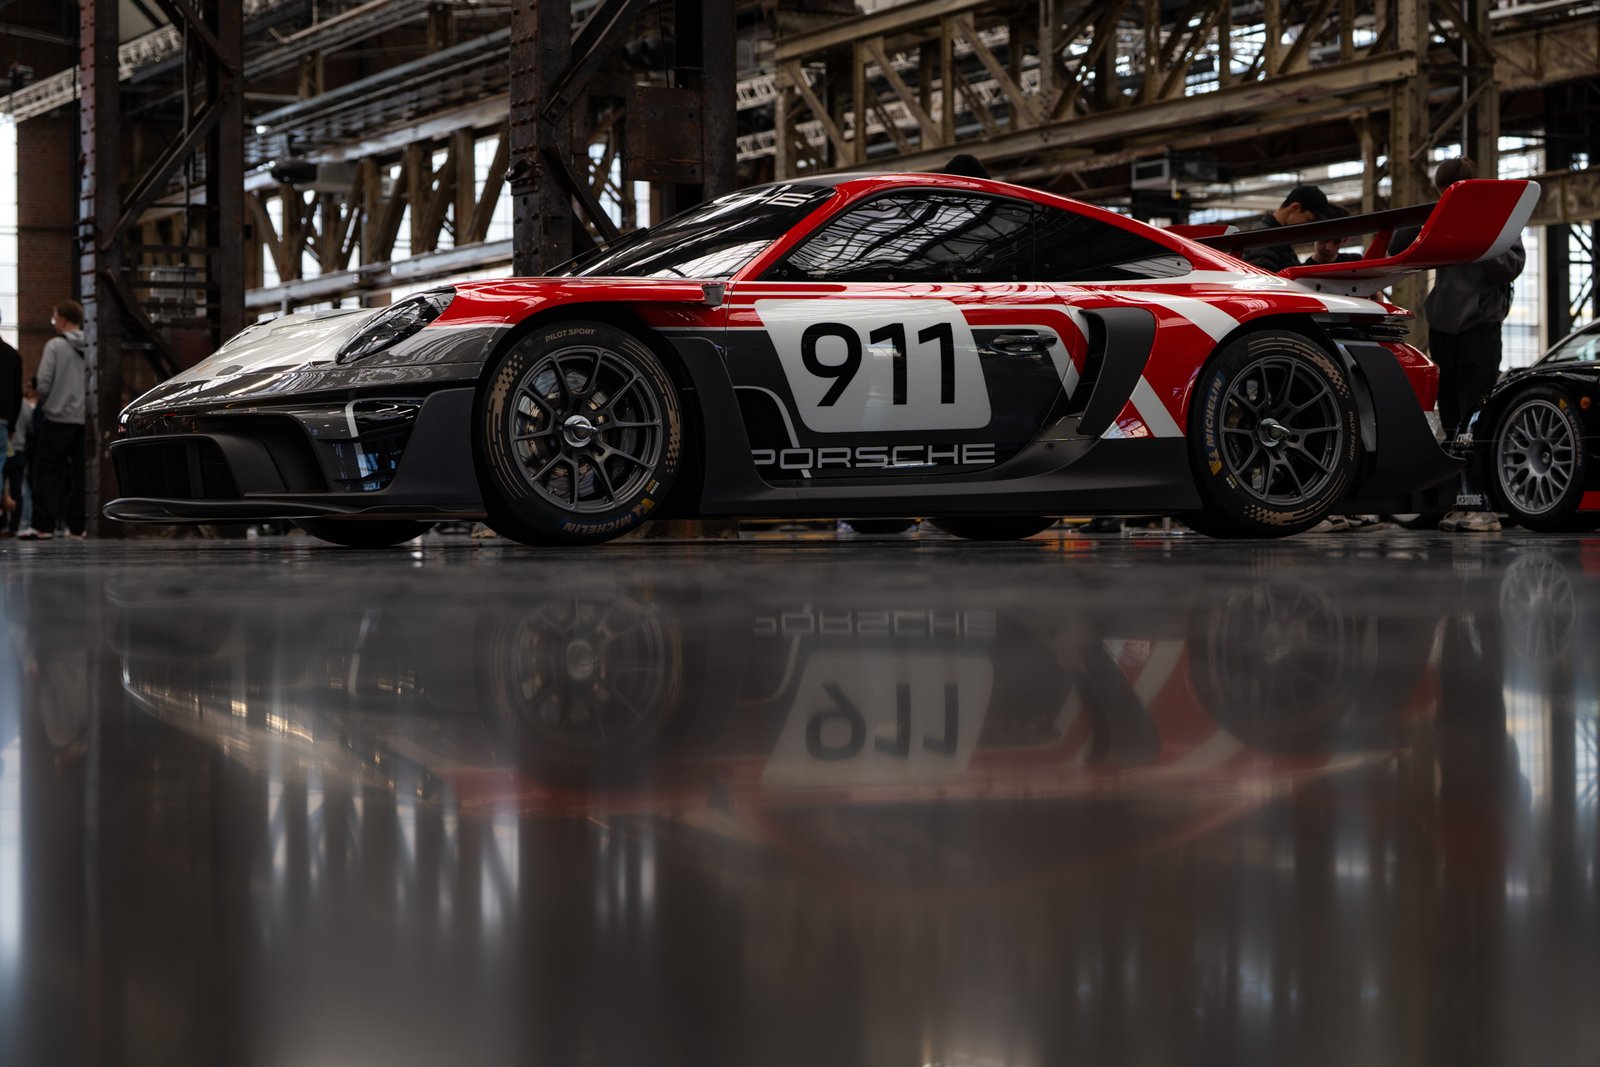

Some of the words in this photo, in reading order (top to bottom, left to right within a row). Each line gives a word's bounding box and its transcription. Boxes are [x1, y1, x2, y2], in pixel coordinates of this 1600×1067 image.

[545, 329, 567, 342] PILOT
[568, 328, 596, 336] SPORT
[800, 322, 956, 408] 911
[1204, 378, 1223, 447] MICHELIN
[750, 442, 996, 470] PORSCHE
[562, 514, 632, 534] MICHELIN
